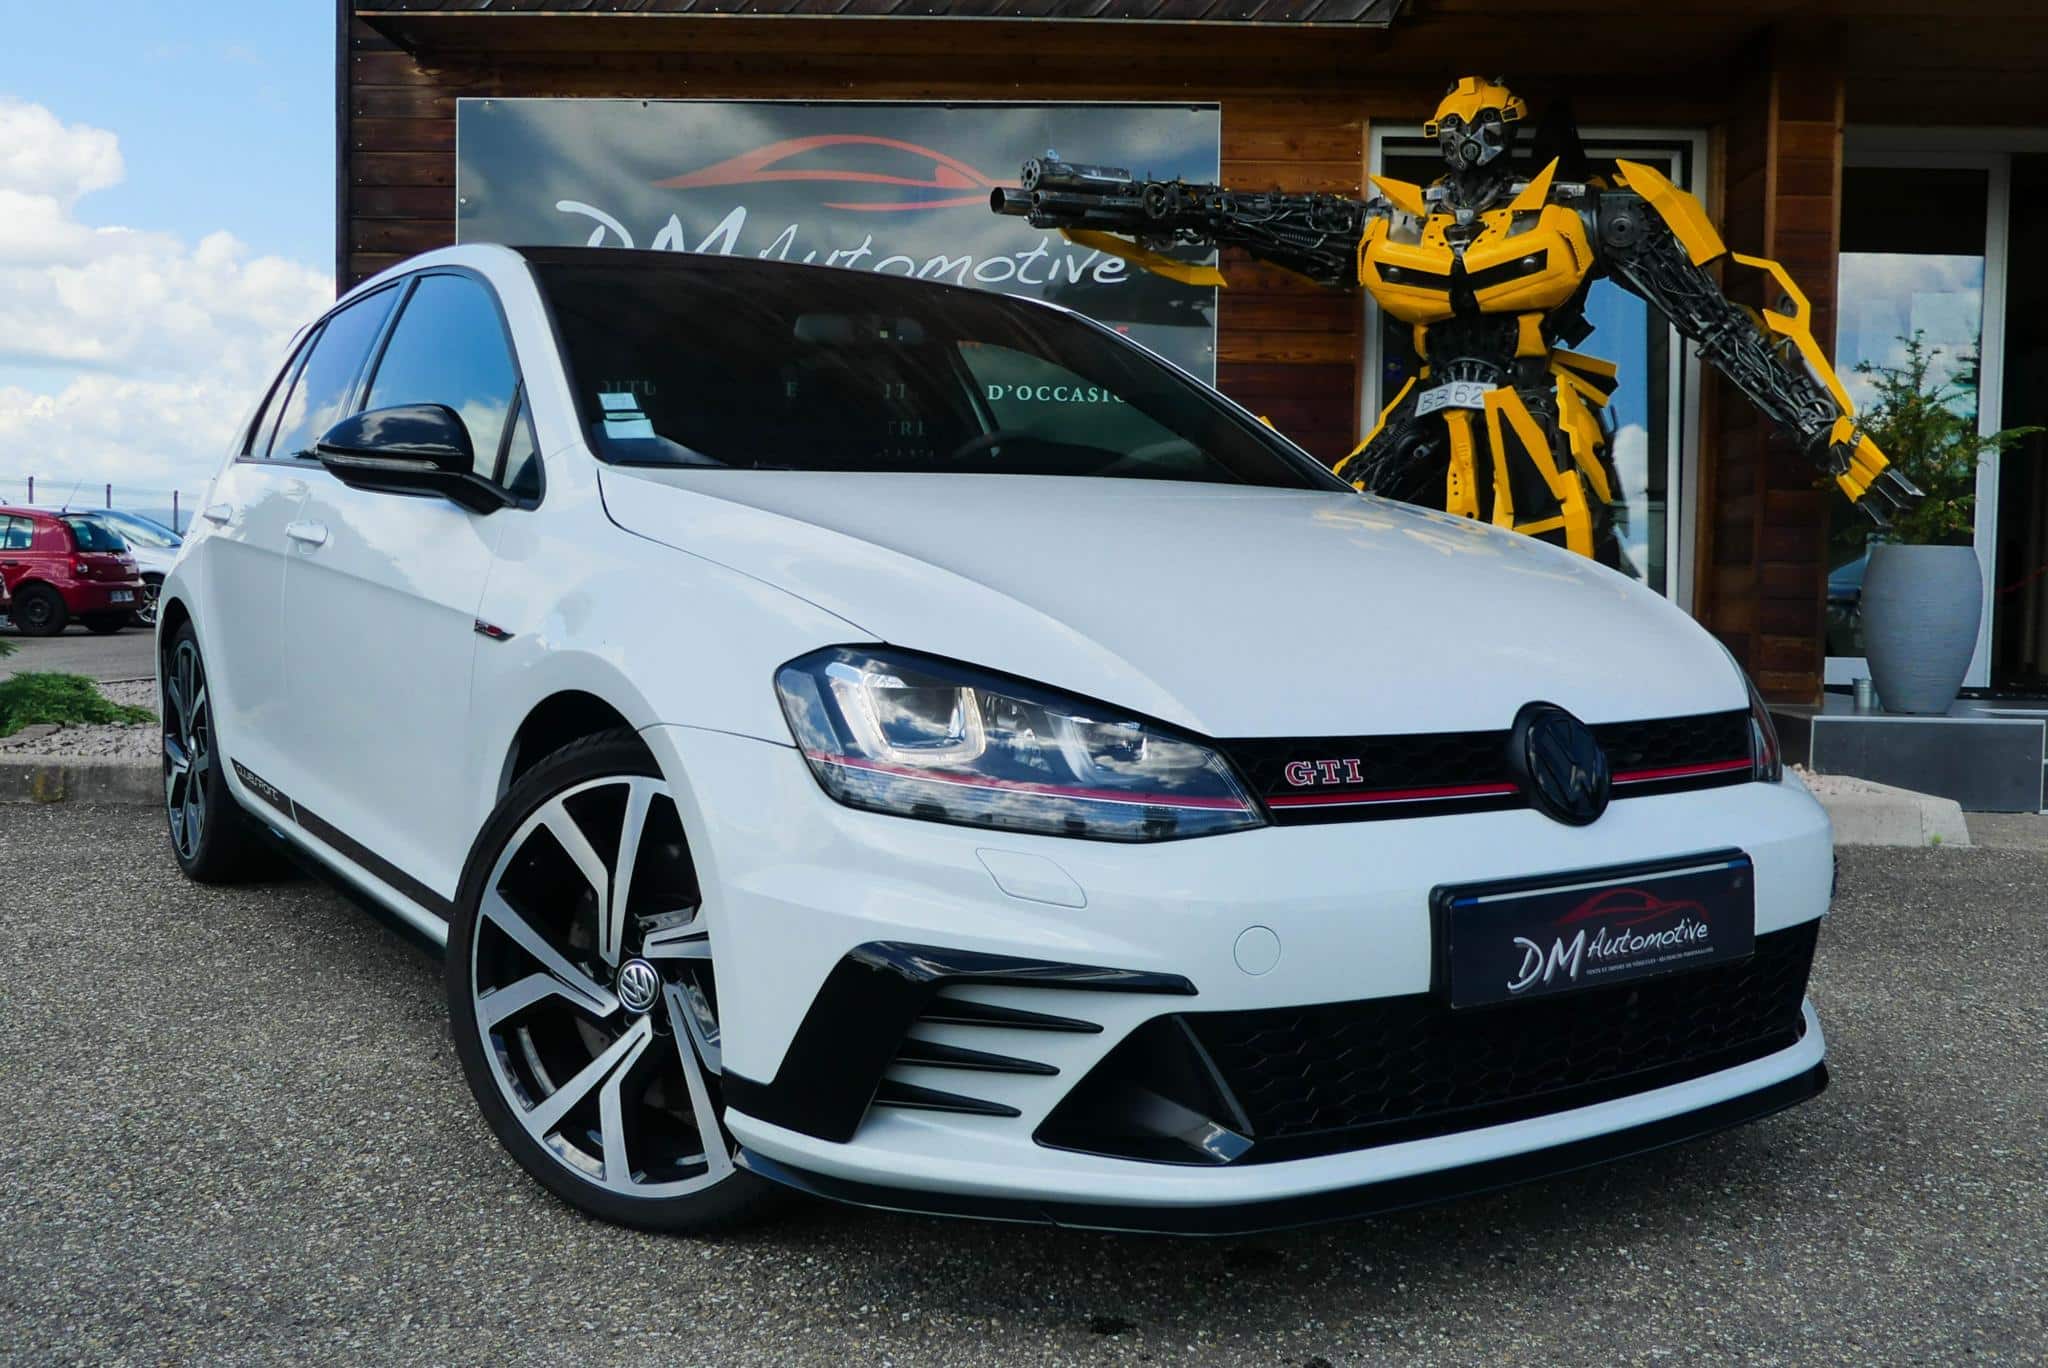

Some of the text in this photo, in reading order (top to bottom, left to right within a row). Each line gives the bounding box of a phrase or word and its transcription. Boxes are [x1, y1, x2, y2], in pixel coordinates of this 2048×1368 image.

[987, 384, 1125, 403] D'OCCASI
[1284, 758, 1364, 786] GTI
[1507, 929, 1586, 989] DM
[1587, 917, 1709, 959] Automotive
